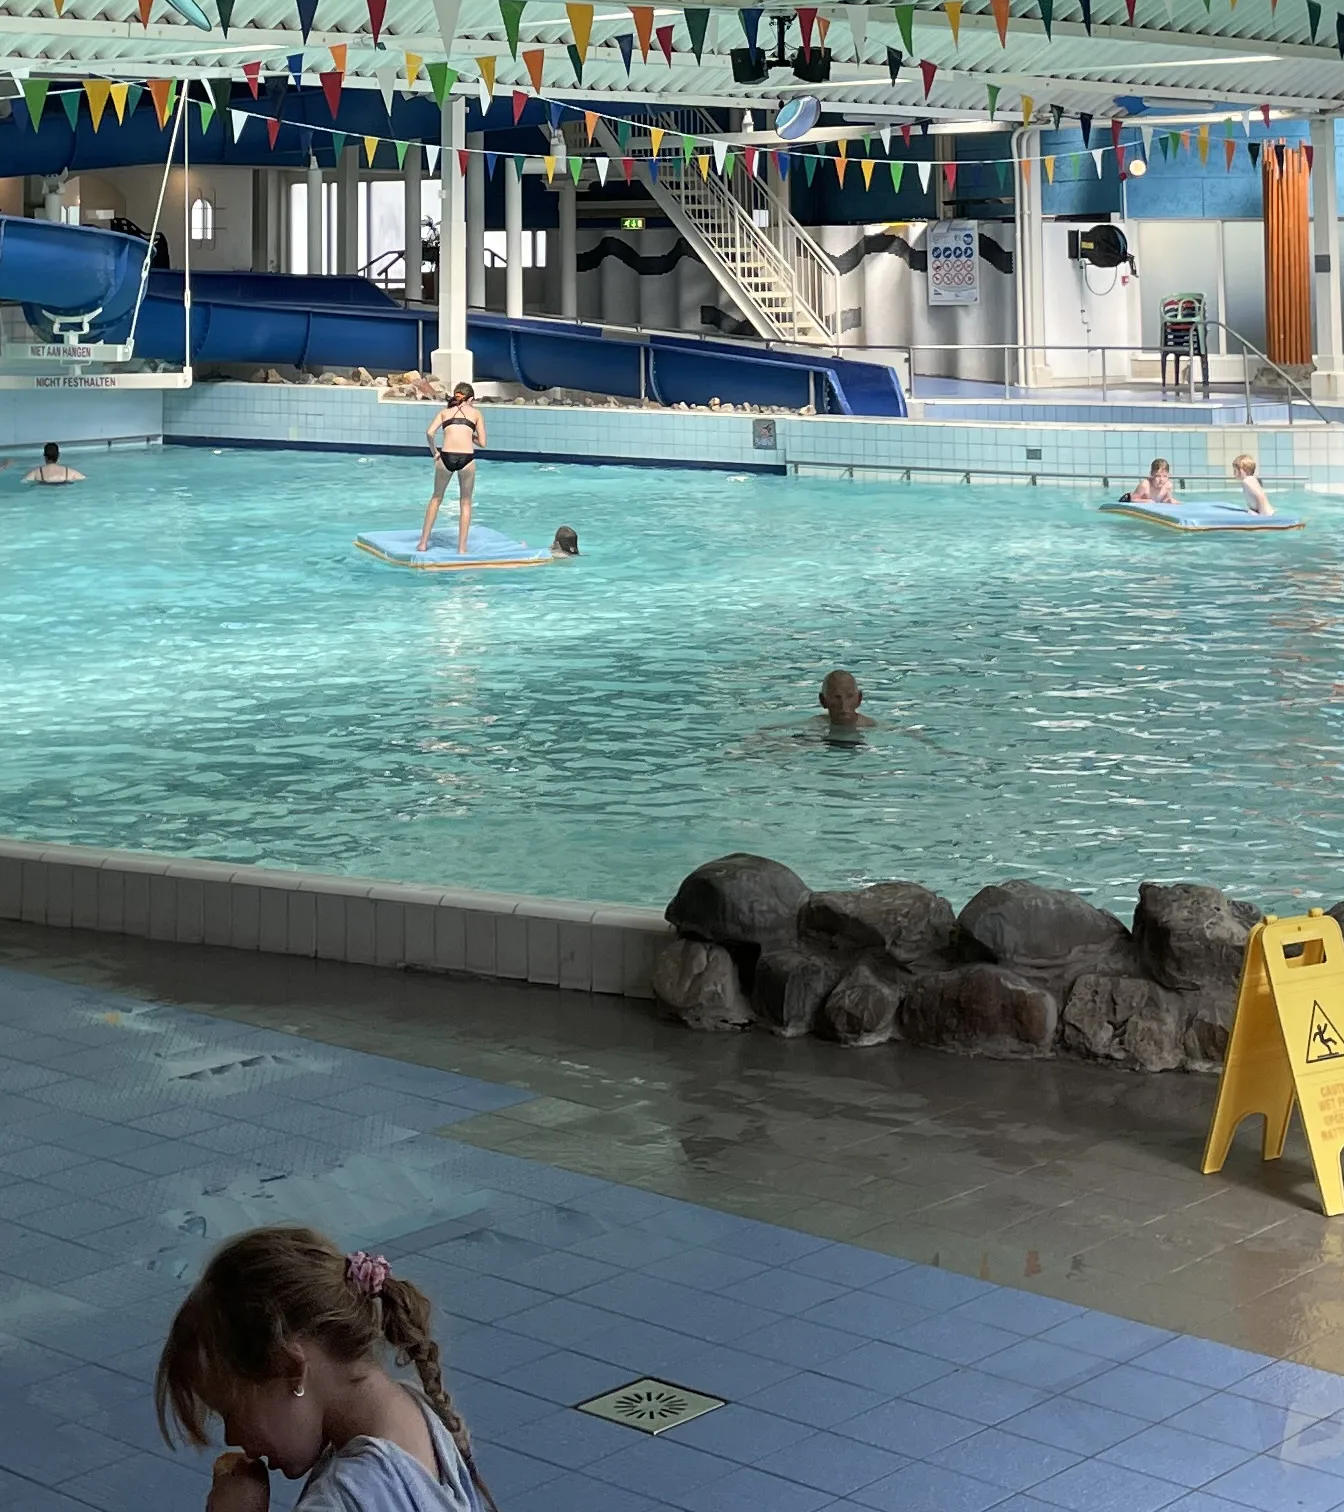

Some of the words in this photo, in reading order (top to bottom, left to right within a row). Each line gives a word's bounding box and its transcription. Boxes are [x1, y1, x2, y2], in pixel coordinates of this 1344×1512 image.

[30, 346, 45, 356] NIET
[47, 346, 61, 357] AAN
[63, 347, 91, 358] HANGEN
[36, 377, 60, 387] NICHT
[63, 377, 116, 387] FESTHALTEN
